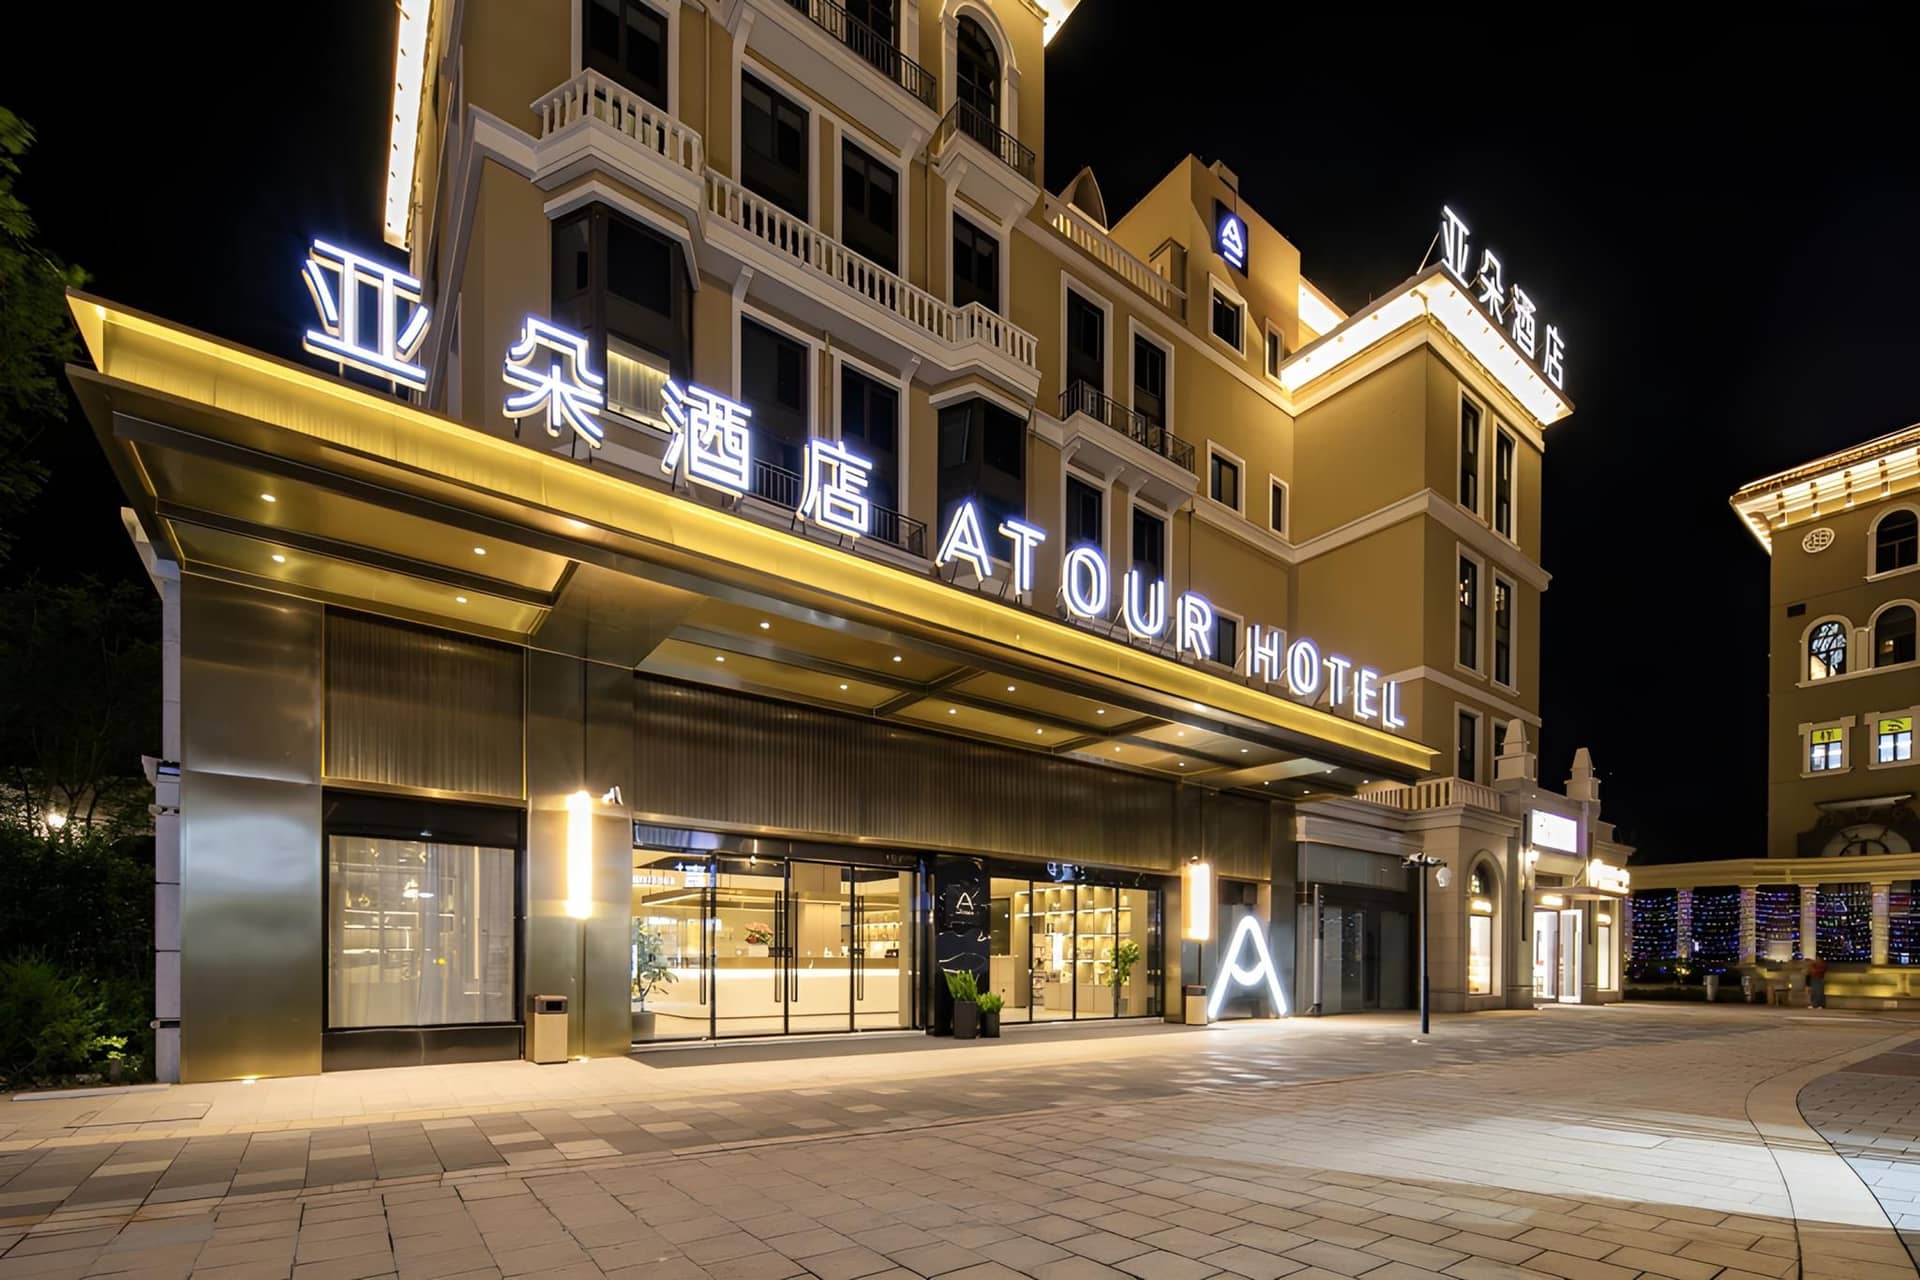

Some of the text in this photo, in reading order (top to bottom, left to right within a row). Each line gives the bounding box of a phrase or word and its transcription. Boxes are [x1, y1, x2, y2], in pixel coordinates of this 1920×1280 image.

[303, 238, 873, 540] 亚朵酒店
[1442, 205, 1565, 390] 亚朵酒店
[936, 502, 1405, 728] ATOUR HOTEL
[1208, 915, 1287, 1018] A
